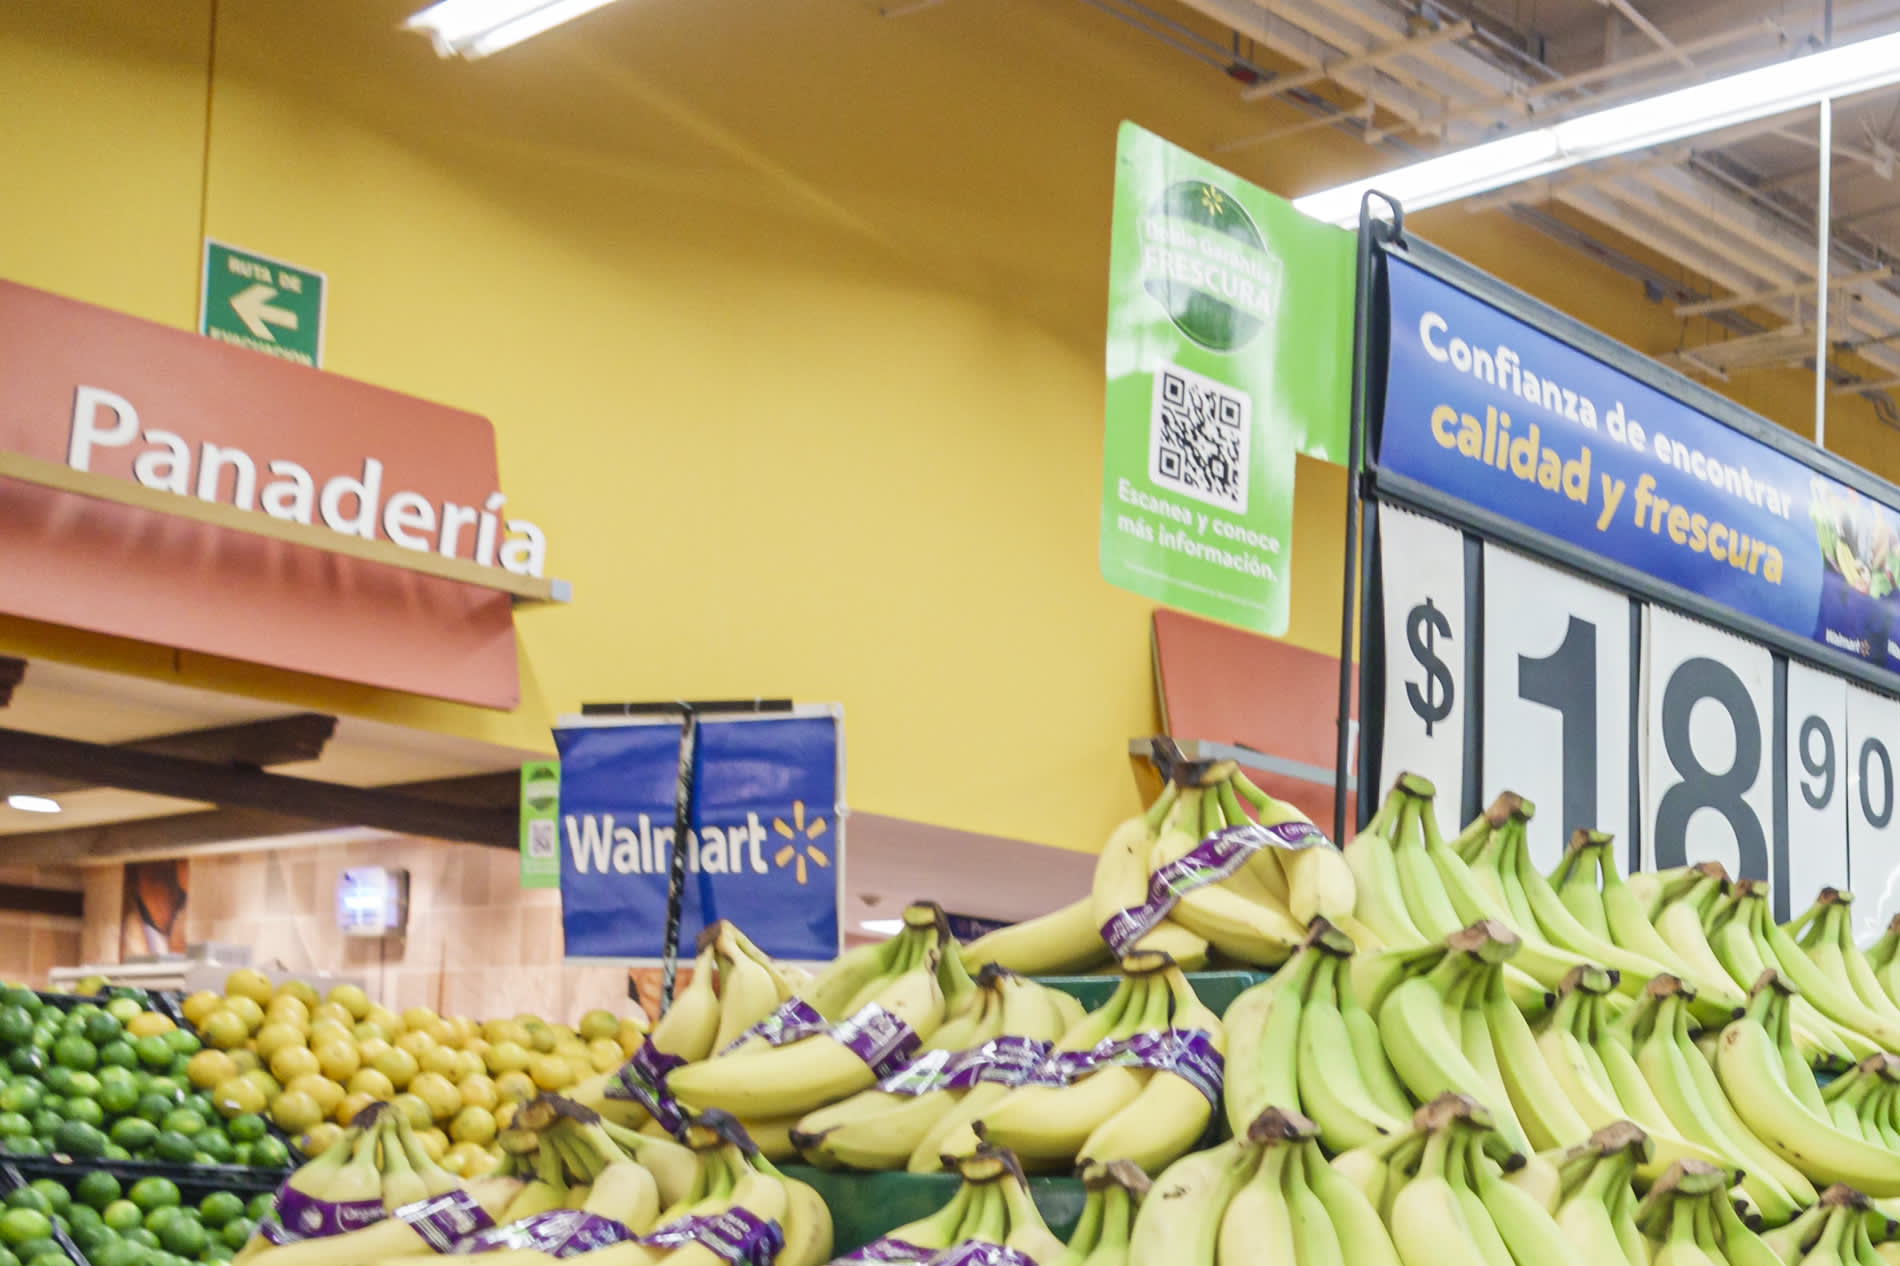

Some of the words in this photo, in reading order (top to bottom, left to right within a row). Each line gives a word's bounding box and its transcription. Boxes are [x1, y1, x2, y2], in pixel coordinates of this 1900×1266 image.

[227, 254, 273, 283] RUTA
[278, 270, 303, 294] DE
[1144, 245, 1271, 316] FRESCURA
[1418, 311, 1598, 432] Confianza
[1605, 401, 1648, 452] de
[1653, 432, 1792, 520] encontrar
[67, 385, 547, 579] Panadería
[1117, 476, 1193, 525] Escanea
[1196, 511, 1210, 536] y
[1212, 518, 1281, 554] conoce
[1430, 404, 1592, 504] calidad
[1596, 471, 1626, 531] y
[1634, 473, 1784, 585] frescura
[1117, 513, 1155, 543] más
[1158, 521, 1279, 583] información.
